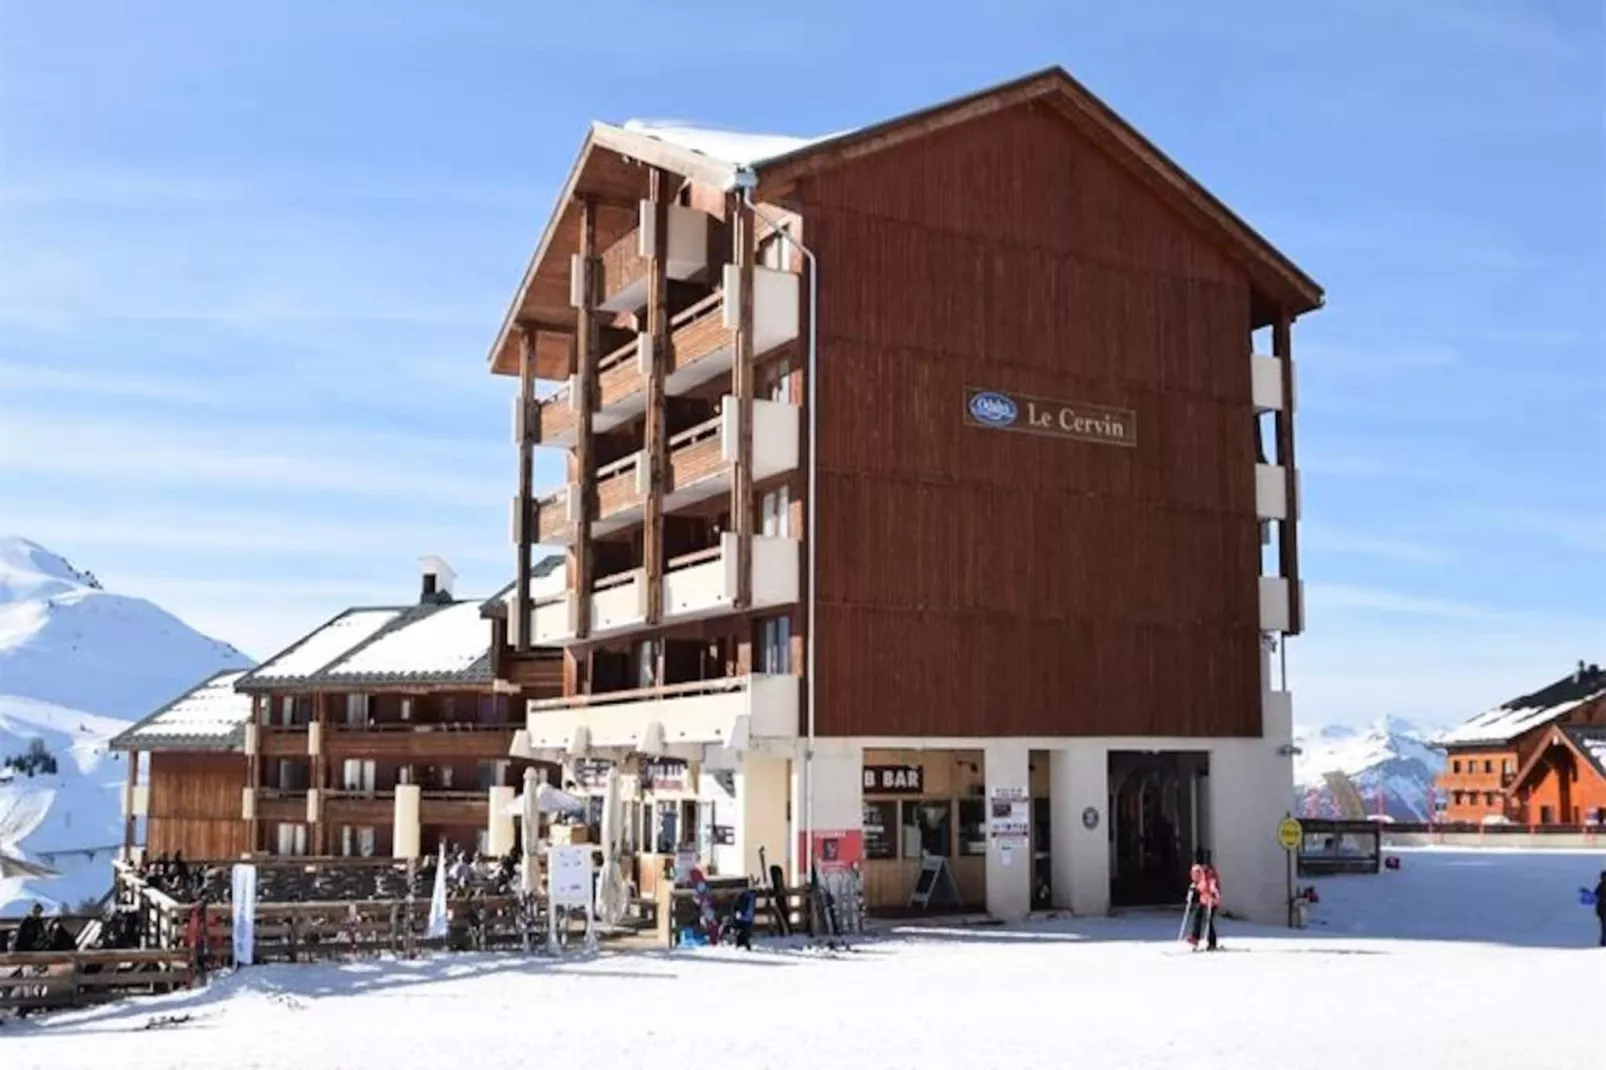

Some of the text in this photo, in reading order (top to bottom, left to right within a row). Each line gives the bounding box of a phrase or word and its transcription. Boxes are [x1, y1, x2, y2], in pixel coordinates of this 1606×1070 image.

[1028, 402, 1052, 428] Le
[1059, 407, 1124, 437] Cervin
[882, 769, 920, 788] BAR
